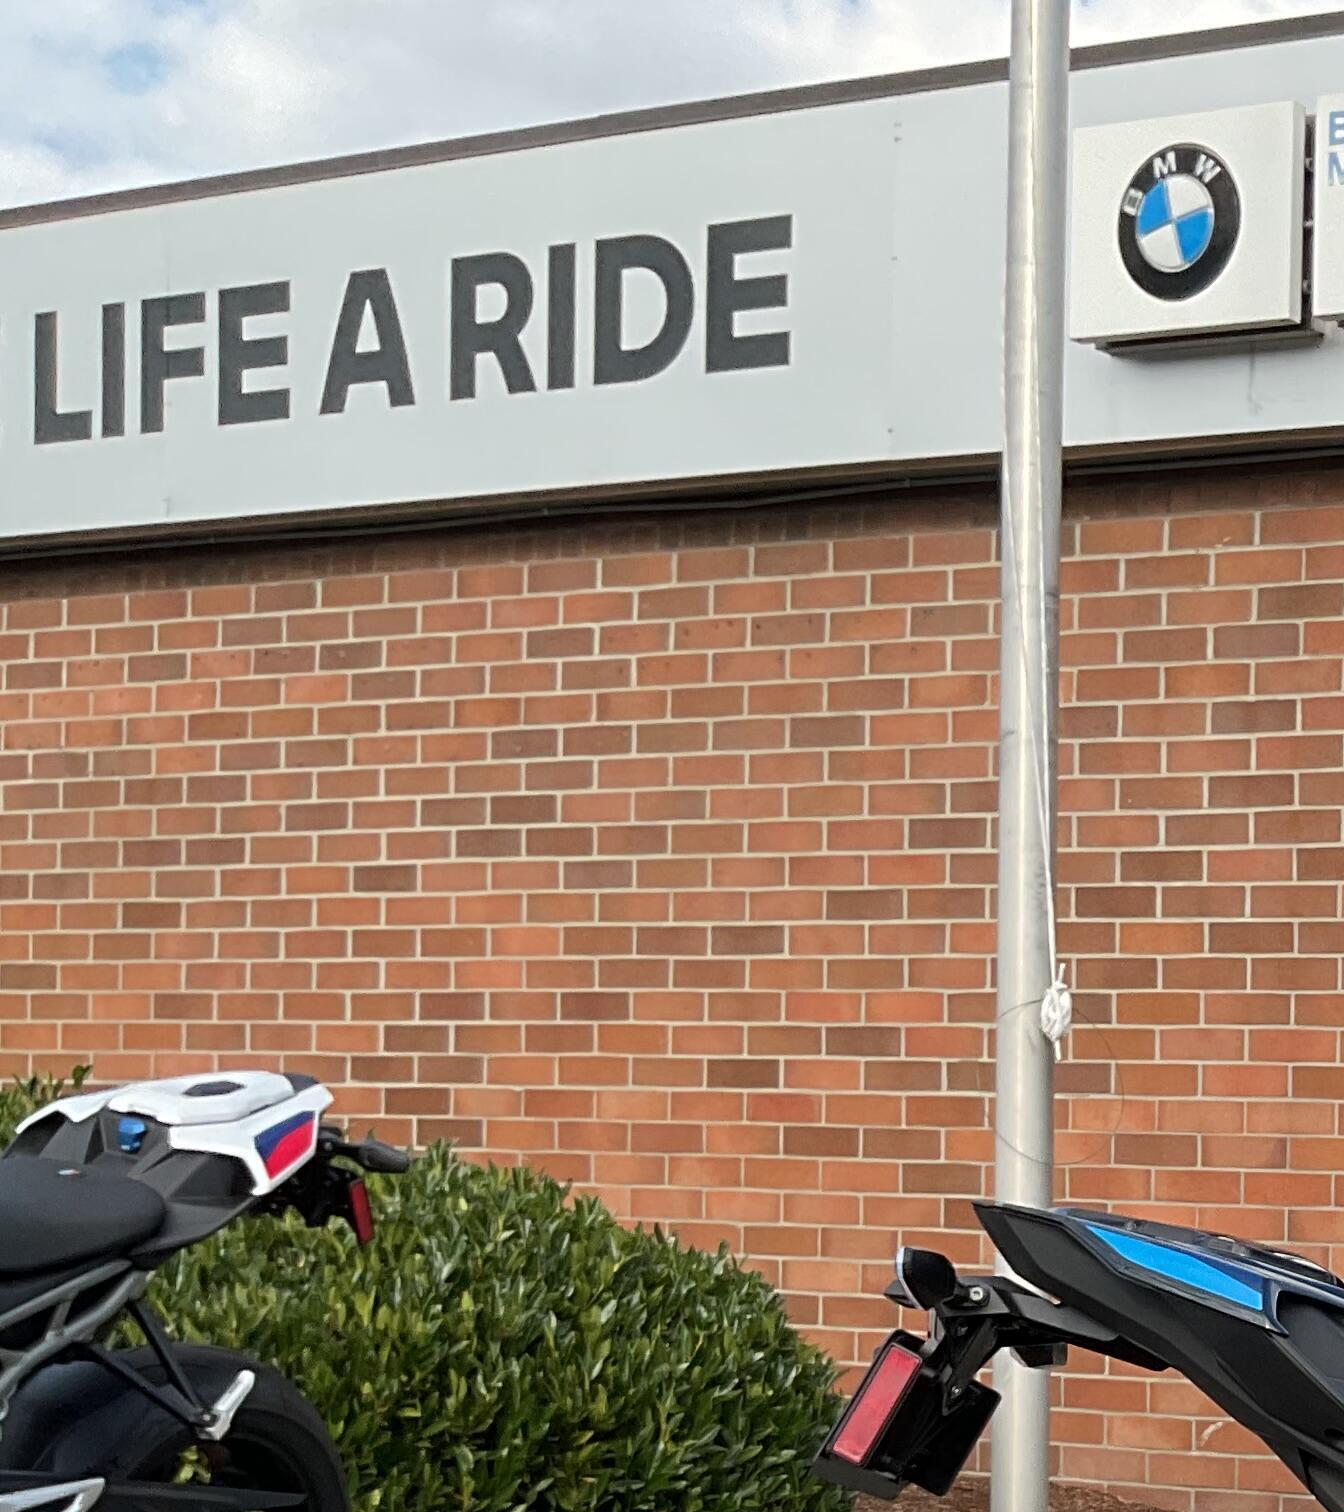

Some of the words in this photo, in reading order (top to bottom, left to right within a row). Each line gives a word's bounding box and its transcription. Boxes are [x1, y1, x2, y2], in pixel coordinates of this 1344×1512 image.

[34, 279, 290, 445] LIFE
[319, 267, 416, 415] A
[449, 214, 793, 401] RIDE
